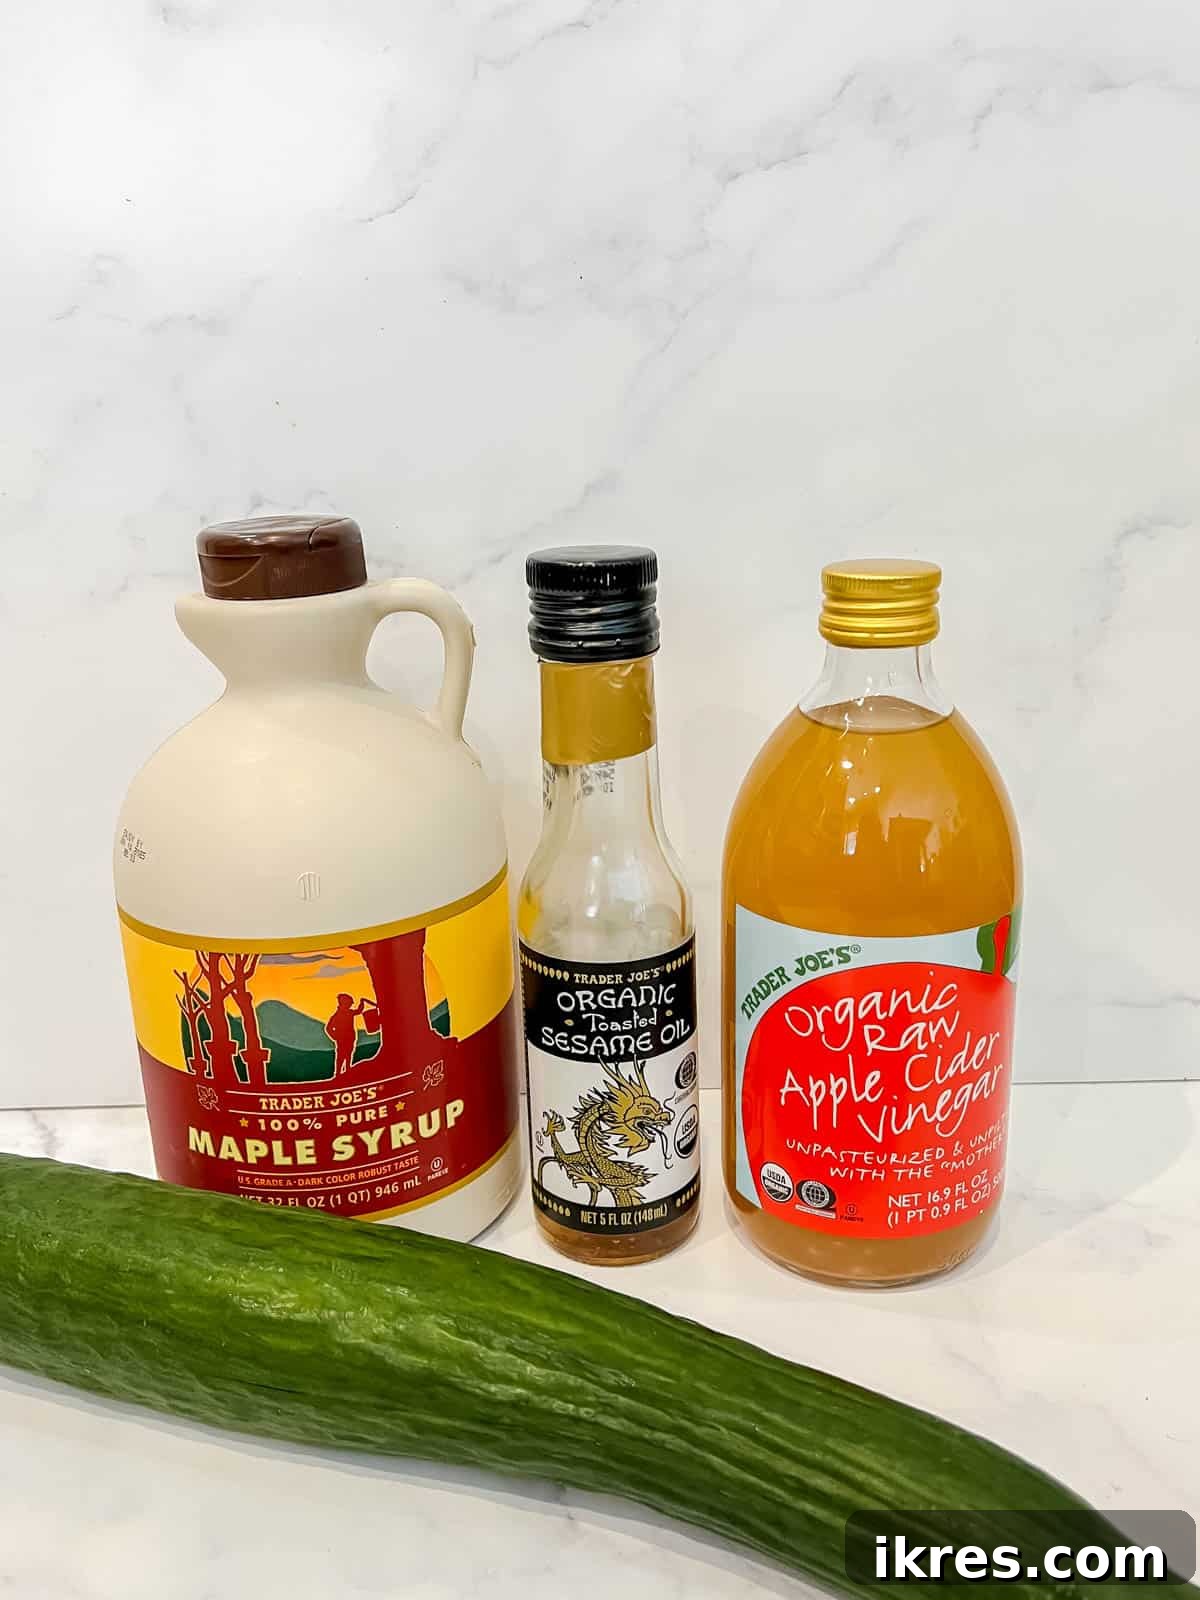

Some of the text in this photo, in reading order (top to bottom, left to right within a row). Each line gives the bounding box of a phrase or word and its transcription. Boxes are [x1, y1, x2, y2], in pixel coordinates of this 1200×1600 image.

[574, 972, 623, 985] TRADER
[740, 966, 792, 1020] TRADER
[556, 983, 677, 1012] ORGANIC
[784, 970, 958, 1052] Organic
[581, 1007, 658, 1032] Toasted
[541, 1018, 691, 1057] SESAME OIL
[779, 1031, 1000, 1131] Apple Cider
[259, 1095, 325, 1111] TRADER
[188, 1098, 466, 1166] MAPLE SYRUP
[258, 1105, 389, 1132] 100% PURE
[785, 1138, 944, 1166] UNPASTEURIZED
[952, 1140, 964, 1157] &
[253, 1177, 284, 1187] GRADE
[325, 1172, 356, 1186] COLOR
[358, 1164, 393, 1180] ROBUST
[394, 1155, 420, 1171] TASTE
[829, 1166, 892, 1182] WITH
[893, 1166, 934, 1182] THE
[306, 1196, 326, 1209] OZ
[349, 1188, 371, 1204] QT)
[375, 1180, 399, 1198] 946
[403, 1175, 422, 1191] mL
[887, 1192, 922, 1210] NET
[927, 1187, 951, 1204] 16.9
[955, 1181, 969, 1197] FL
[971, 1168, 988, 1189] OZ
[580, 1209, 598, 1225] NET
[600, 1212, 607, 1225] 5
[608, 1212, 619, 1226] FL
[620, 1212, 632, 1226] OZ
[906, 1207, 927, 1224] PT
[930, 1203, 951, 1220] 0.9
[955, 1197, 969, 1213] FL
